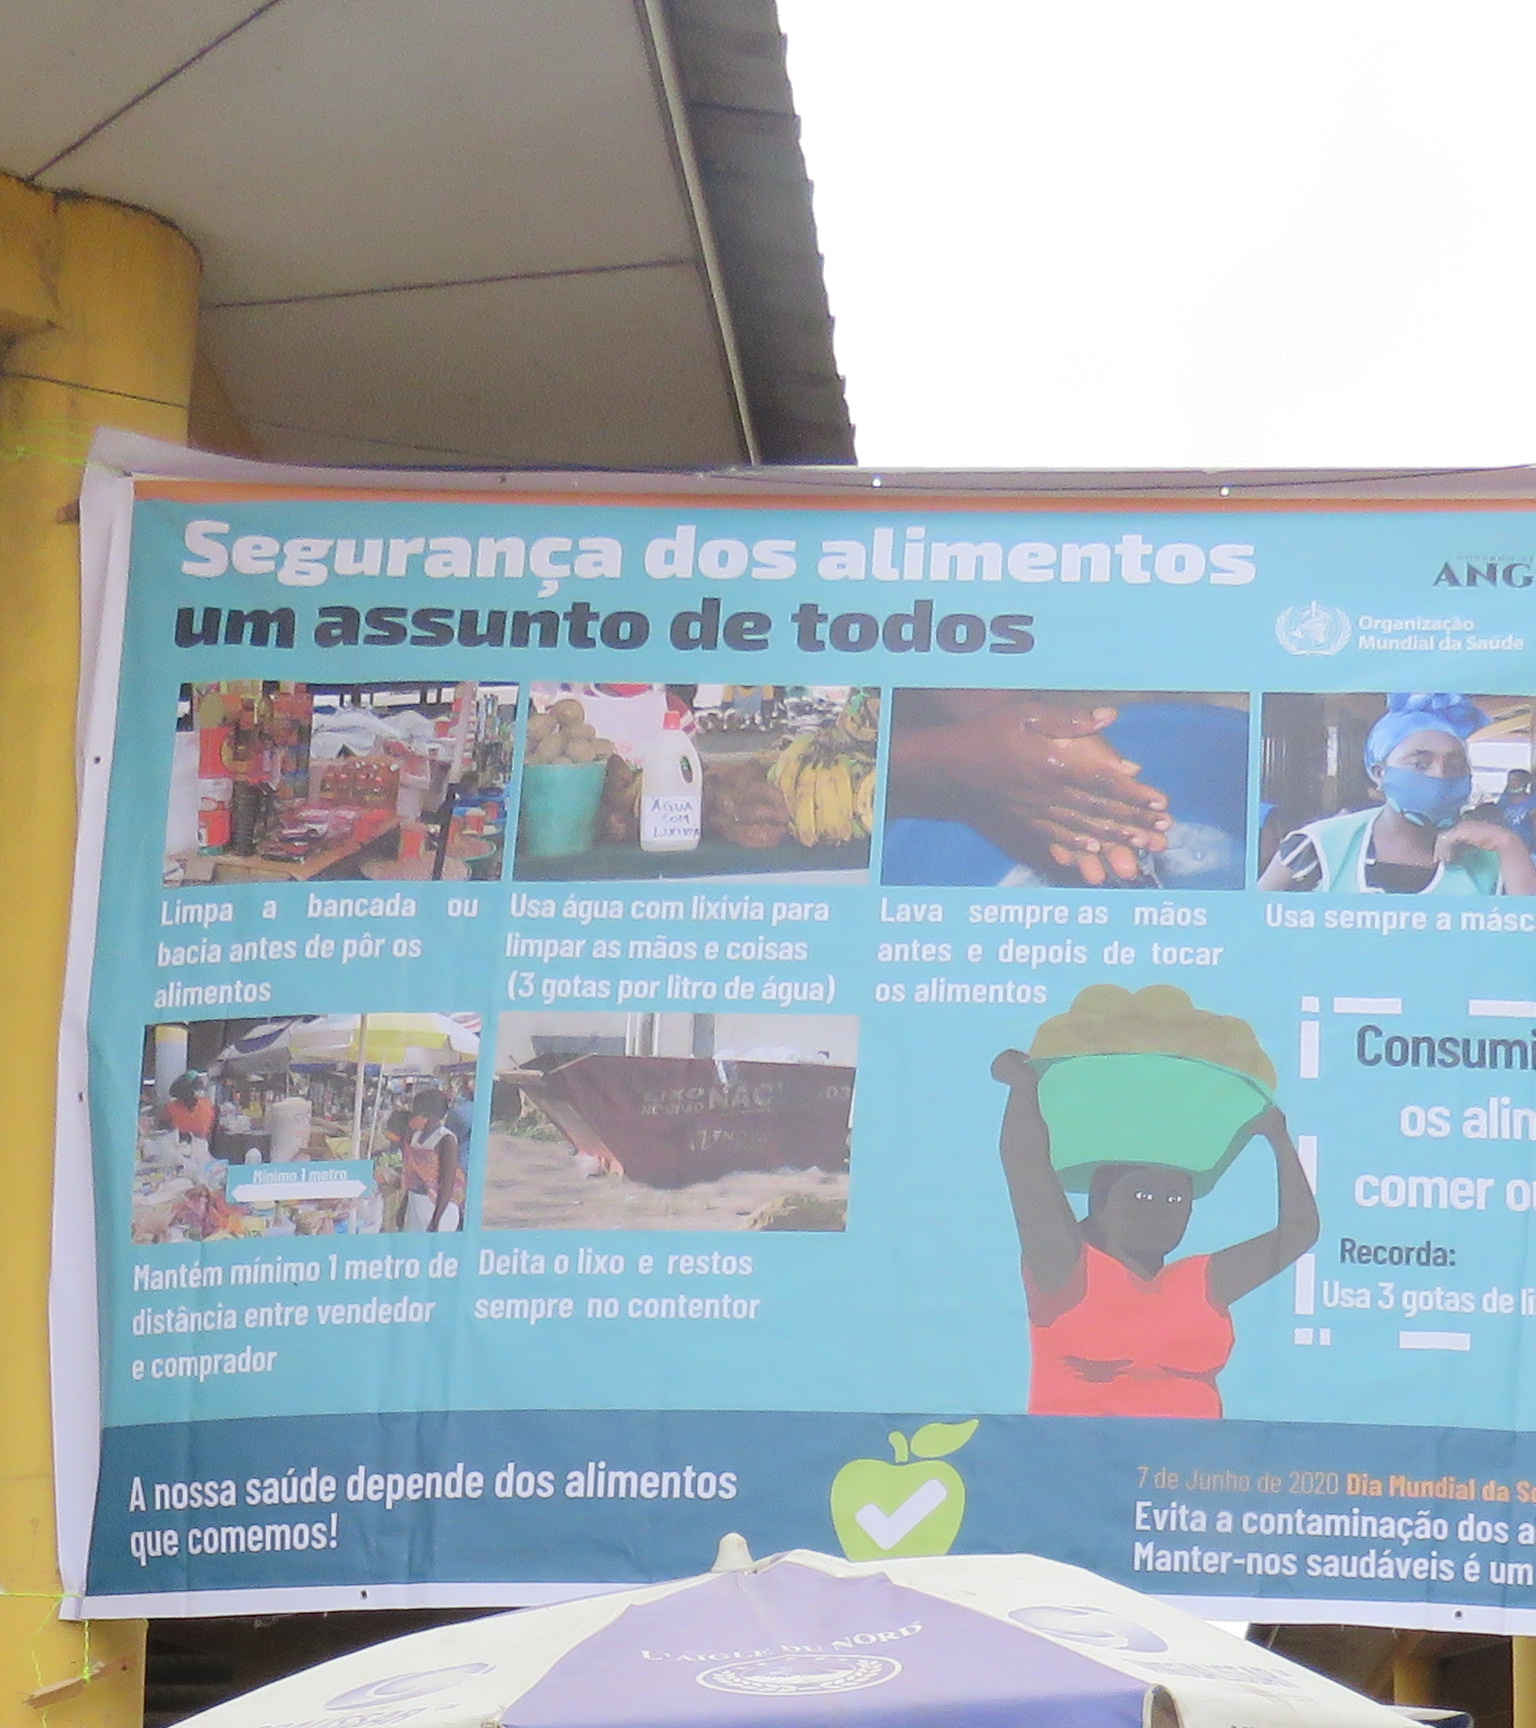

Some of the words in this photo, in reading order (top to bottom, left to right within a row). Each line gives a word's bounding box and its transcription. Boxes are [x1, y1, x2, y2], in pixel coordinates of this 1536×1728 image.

[182, 517, 623, 598] Segurança
[645, 523, 797, 579] dos
[818, 526, 1256, 585] alimentos
[175, 604, 295, 648] um
[314, 602, 649, 649] assunto
[670, 597, 771, 651] de
[791, 600, 1034, 654] todos
[1358, 615, 1474, 635] Organização
[1358, 634, 1435, 651] Mundial
[1438, 635, 1462, 651] da
[1466, 633, 1525, 651] Saúde
[160, 899, 234, 929] Limpa
[260, 900, 278, 920] a
[308, 893, 417, 918] bancada
[448, 898, 480, 917] ou
[509, 893, 557, 918] Usa
[562, 894, 625, 925] água
[631, 899, 686, 920] com
[690, 895, 766, 921] lixívia
[771, 901, 830, 926] para
[879, 896, 944, 923] Lava
[968, 903, 1070, 929] sempre
[1076, 905, 1109, 925] as
[1132, 901, 1208, 928] mãos
[1264, 903, 1316, 929] Usa
[1323, 909, 1428, 935] sempre
[1434, 912, 1453, 932] a
[154, 980, 272, 1009] alimentos
[507, 970, 536, 1001] (3
[540, 975, 612, 1004] gotas
[616, 979, 660, 1004] por
[667, 974, 718, 1000] litro
[723, 976, 755, 1000] de
[761, 975, 836, 1008] água)
[874, 982, 907, 1003] os
[913, 977, 1048, 1005] alimentos
[1401, 1106, 1451, 1138] os
[1354, 1174, 1495, 1210] comer
[478, 1248, 546, 1275] Deita
[553, 1254, 570, 1275] o
[576, 1247, 626, 1274] lixo
[637, 1254, 654, 1274] e
[668, 1251, 754, 1276] restos
[1340, 1238, 1455, 1266] Recorda:
[133, 1261, 224, 1292] Mantém
[229, 1256, 321, 1286] mínimo
[329, 1254, 339, 1280] 1
[344, 1255, 421, 1281] metro
[429, 1251, 460, 1279] de
[133, 1303, 238, 1337] distância
[243, 1302, 310, 1328] entre
[317, 1296, 436, 1325] vendedor
[1321, 1280, 1374, 1309] Usa
[1377, 1282, 1396, 1310] 3
[1400, 1287, 1476, 1319] gotas
[1480, 1287, 1515, 1314] de
[130, 1477, 146, 1512] A
[155, 1480, 236, 1510] nossa
[246, 1467, 336, 1505] saúde
[347, 1463, 484, 1509] depende
[495, 1463, 554, 1498] dos
[565, 1461, 737, 1499] alimentos
[1136, 1466, 1149, 1488] 7
[1154, 1468, 1179, 1490] de
[1185, 1469, 1250, 1491] Junho
[1258, 1472, 1281, 1493] de
[1288, 1472, 1340, 1495] 2020
[1346, 1473, 1382, 1496] Dia
[1389, 1475, 1476, 1501] Mundial
[1482, 1480, 1510, 1502] da
[1136, 1501, 1206, 1532] Evita
[1216, 1512, 1232, 1532] a
[1243, 1508, 1448, 1546] contaminação
[1458, 1513, 1509, 1545] dos
[1134, 1542, 1297, 1576] Manter-nos
[1307, 1549, 1454, 1580] saudáveis
[1464, 1553, 1480, 1582] é
[1490, 1562, 1533, 1585] um
[831, 1620, 923, 1651] NORD
